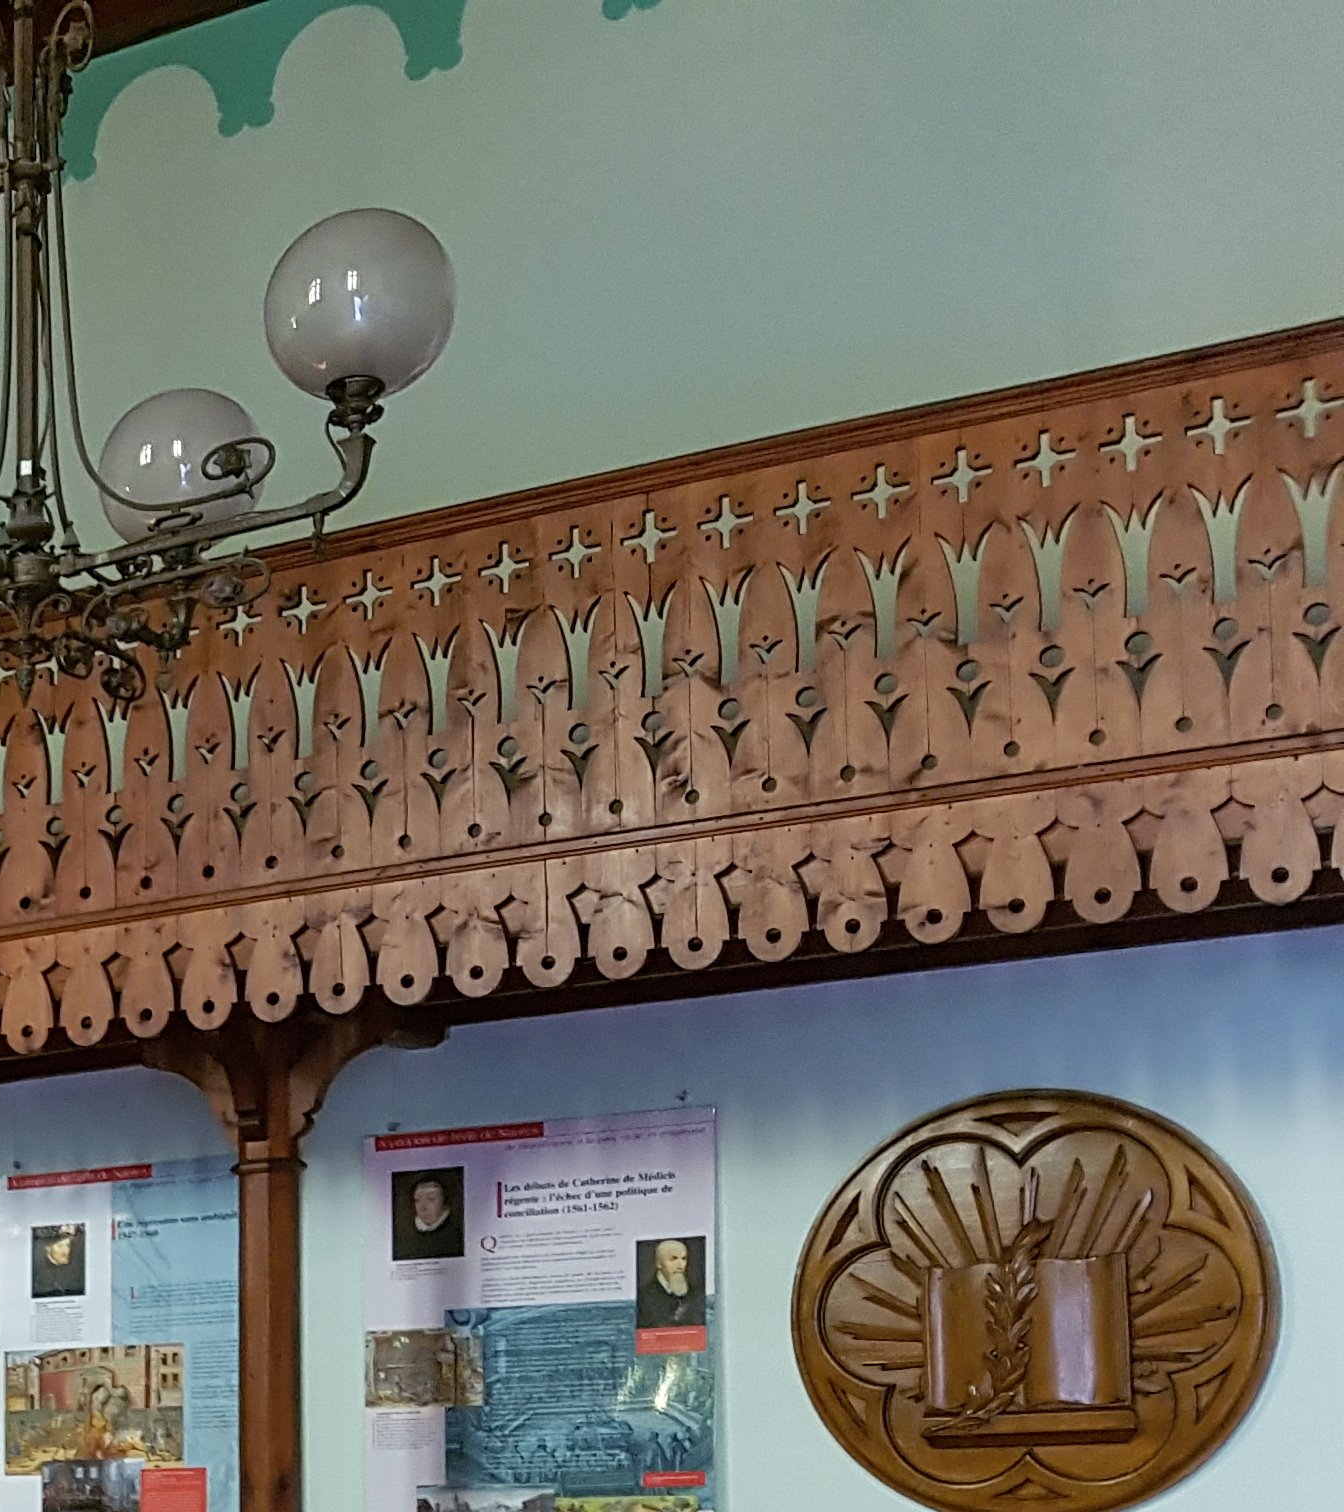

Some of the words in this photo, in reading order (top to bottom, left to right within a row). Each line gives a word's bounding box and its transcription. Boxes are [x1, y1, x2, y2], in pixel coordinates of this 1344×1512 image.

[557, 1177, 570, 1190] de
[622, 1173, 636, 1184] de
[615, 1185, 659, 1200] politique
[661, 1183, 674, 1195] de
